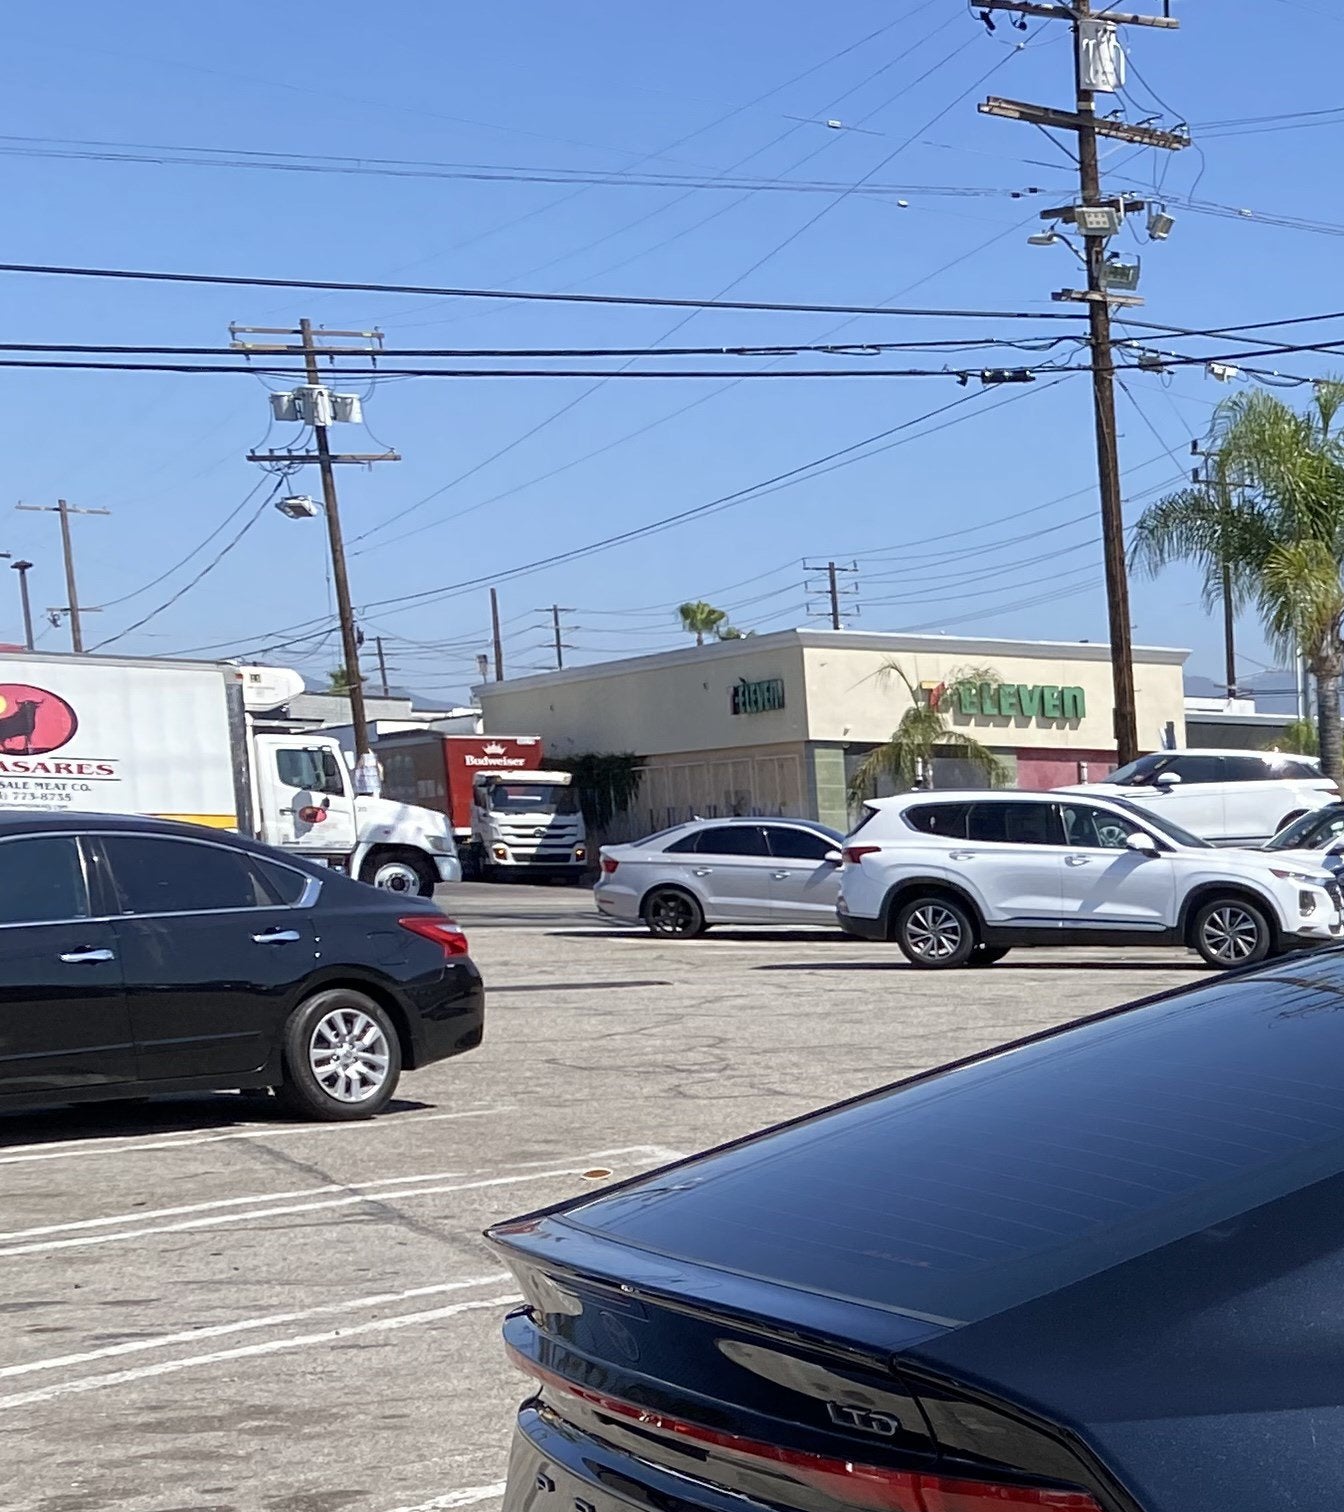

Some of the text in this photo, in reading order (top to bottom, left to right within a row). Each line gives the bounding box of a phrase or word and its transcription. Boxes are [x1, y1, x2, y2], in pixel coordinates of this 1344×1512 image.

[464, 755, 526, 767] Budweiser
[34, 782, 67, 791] MEAT
[826, 1402, 899, 1437] LTD
